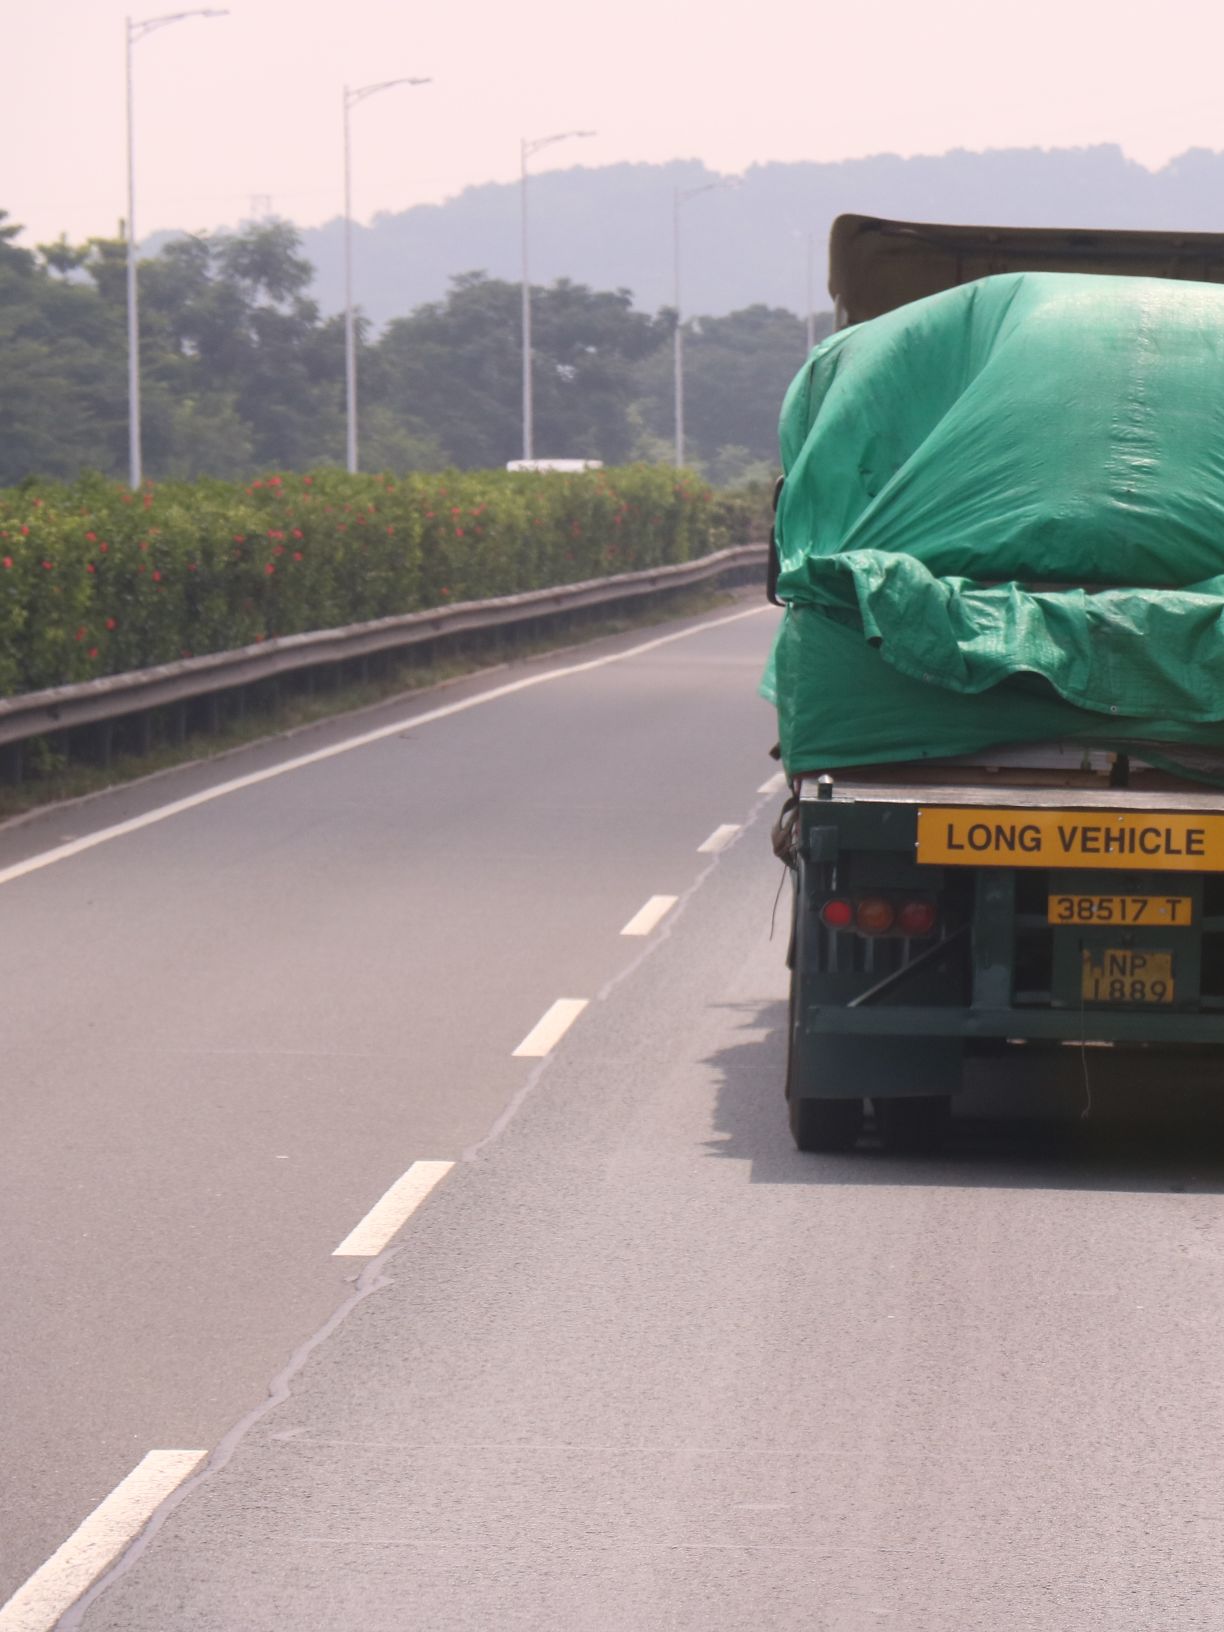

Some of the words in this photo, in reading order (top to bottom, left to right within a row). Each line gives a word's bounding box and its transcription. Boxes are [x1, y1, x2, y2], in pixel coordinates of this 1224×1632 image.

[947, 822, 1042, 852] LONG
[1058, 824, 1206, 857] VEHICLE
[1056, 897, 1148, 922] 38517
[1164, 899, 1183, 922] T
[1093, 978, 1168, 1002] 1889
